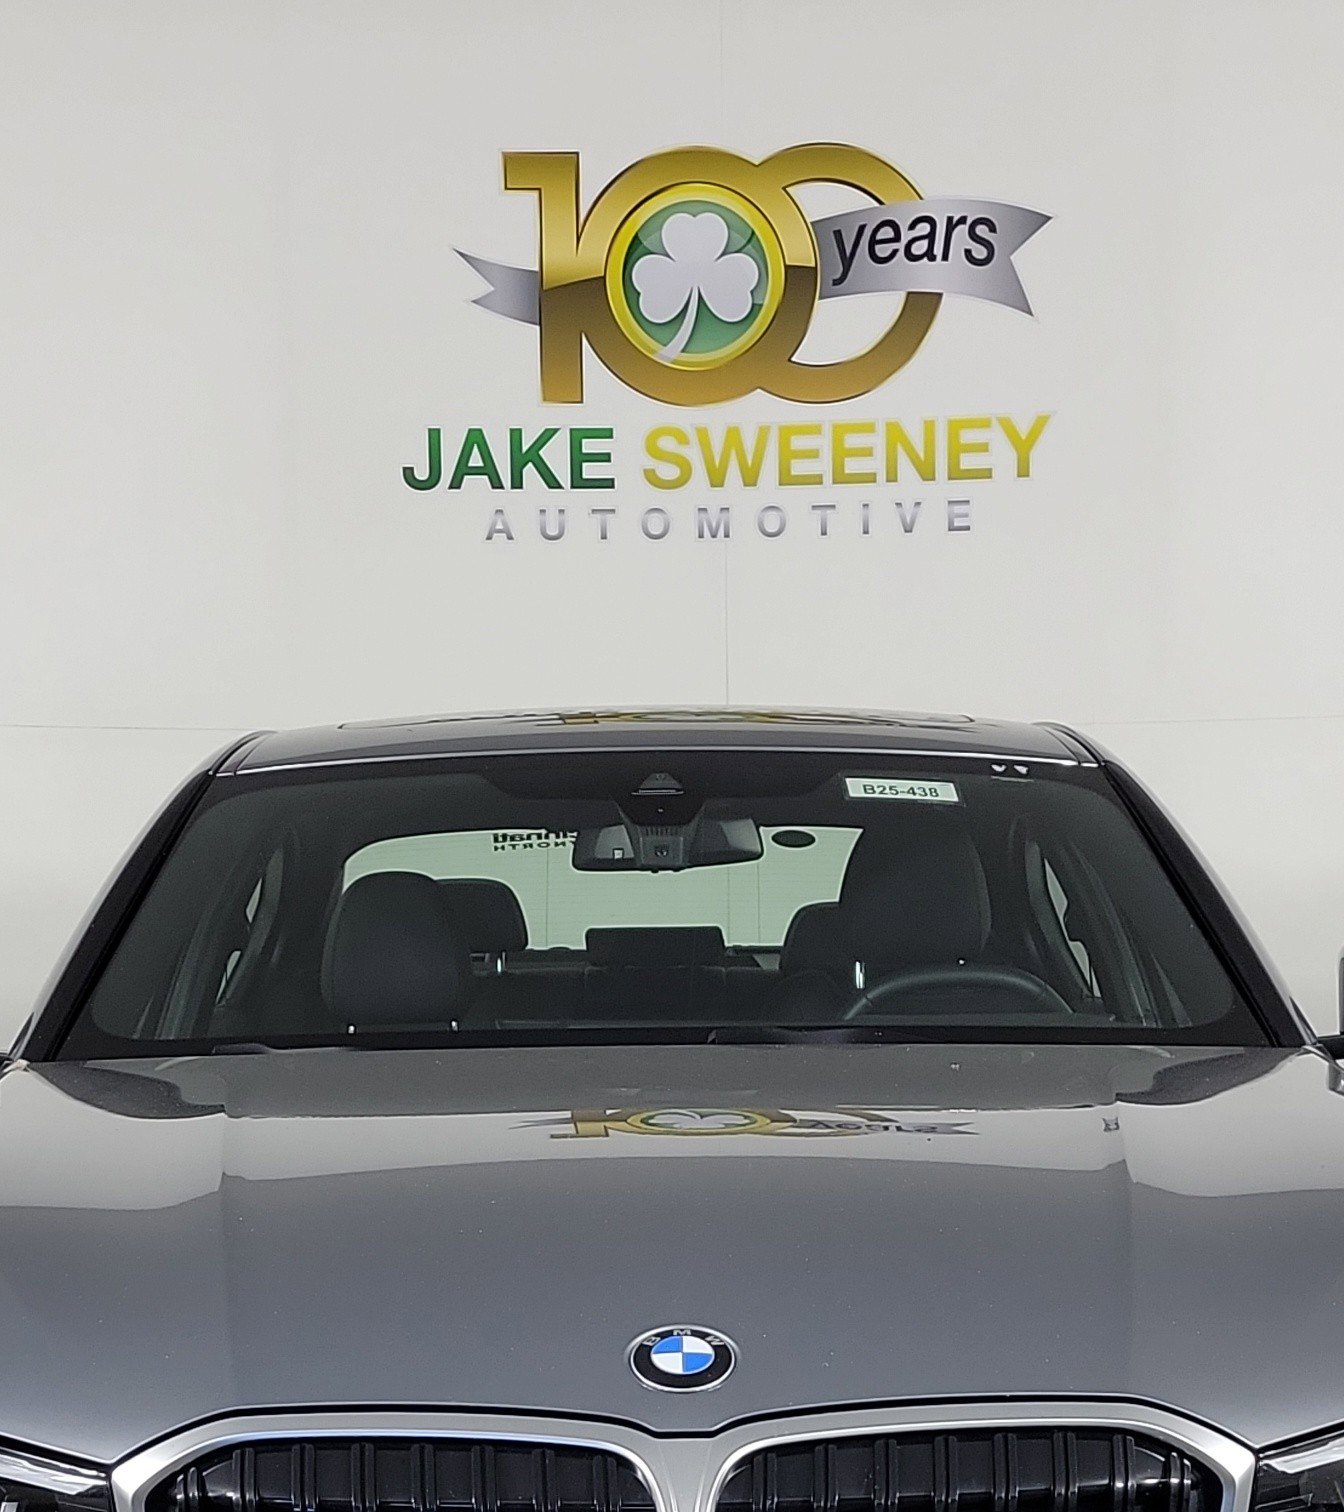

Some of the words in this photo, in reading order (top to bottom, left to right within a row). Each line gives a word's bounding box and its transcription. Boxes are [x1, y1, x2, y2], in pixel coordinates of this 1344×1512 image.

[502, 142, 943, 406] 100
[832, 213, 998, 286] years
[402, 427, 616, 491] JAKE
[642, 415, 1051, 490] SWEENEY
[485, 499, 972, 541] AUTOMOTIVE
[863, 784, 939, 797] B25-438
[642, 1329, 724, 1346] BMW
